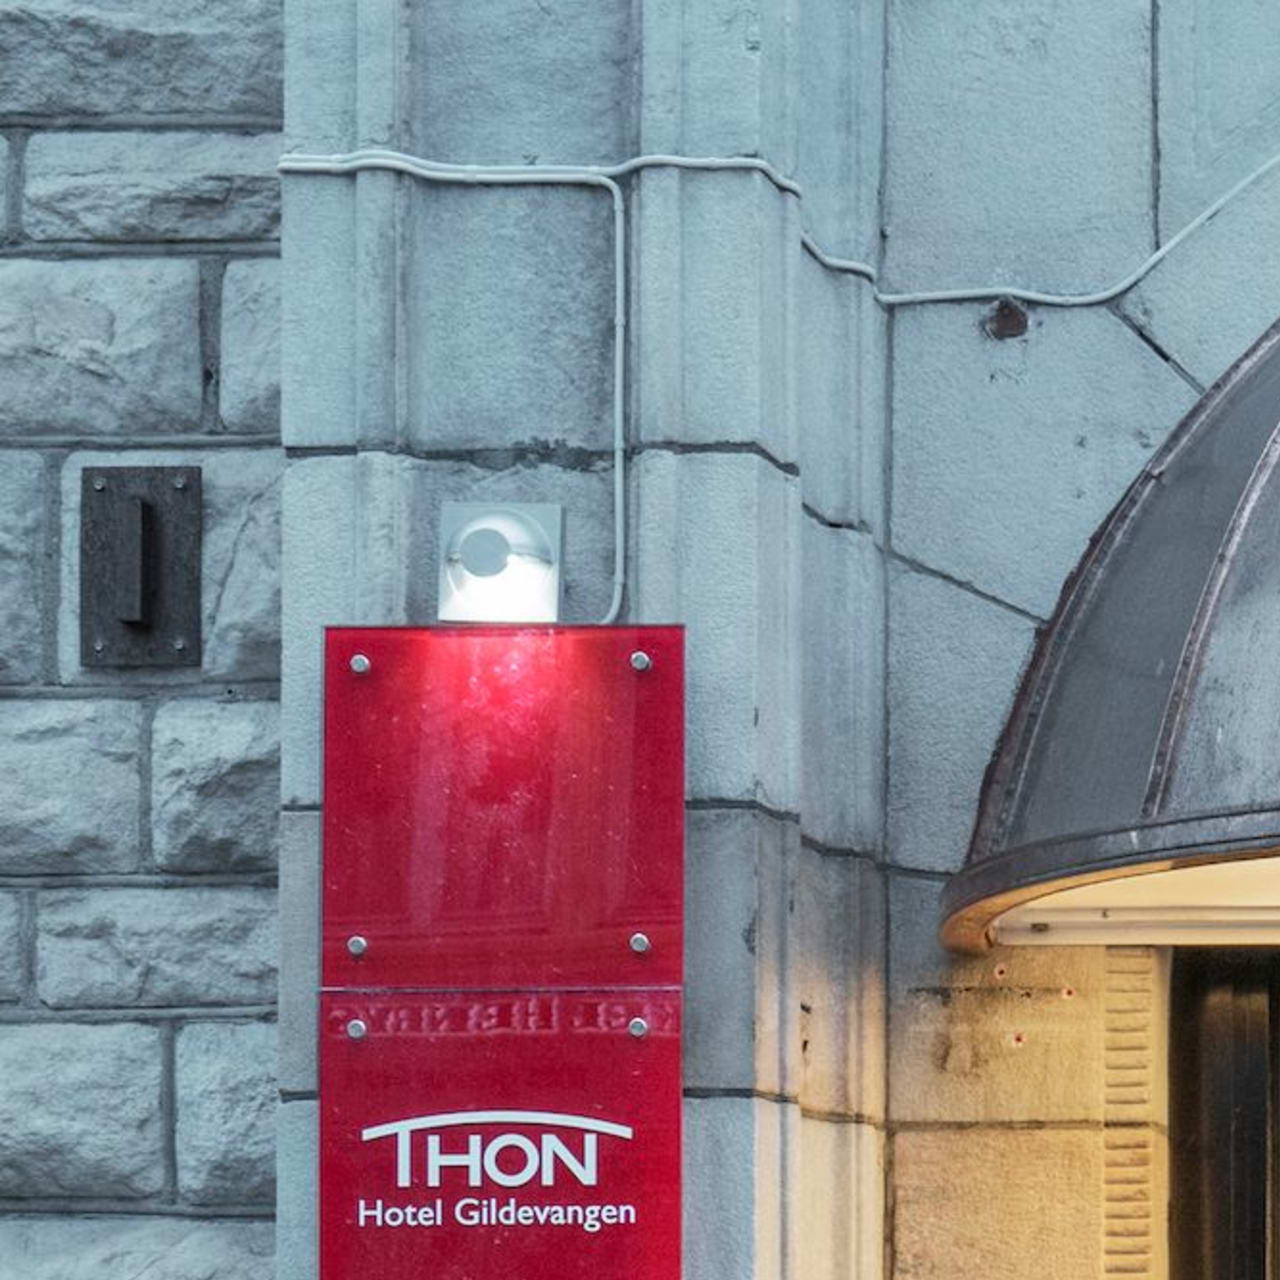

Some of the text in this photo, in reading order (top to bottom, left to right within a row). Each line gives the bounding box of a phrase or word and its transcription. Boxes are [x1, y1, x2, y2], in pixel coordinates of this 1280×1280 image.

[361, 1110, 633, 1188] THON
[358, 1197, 636, 1233] Hotel Gildevangen
